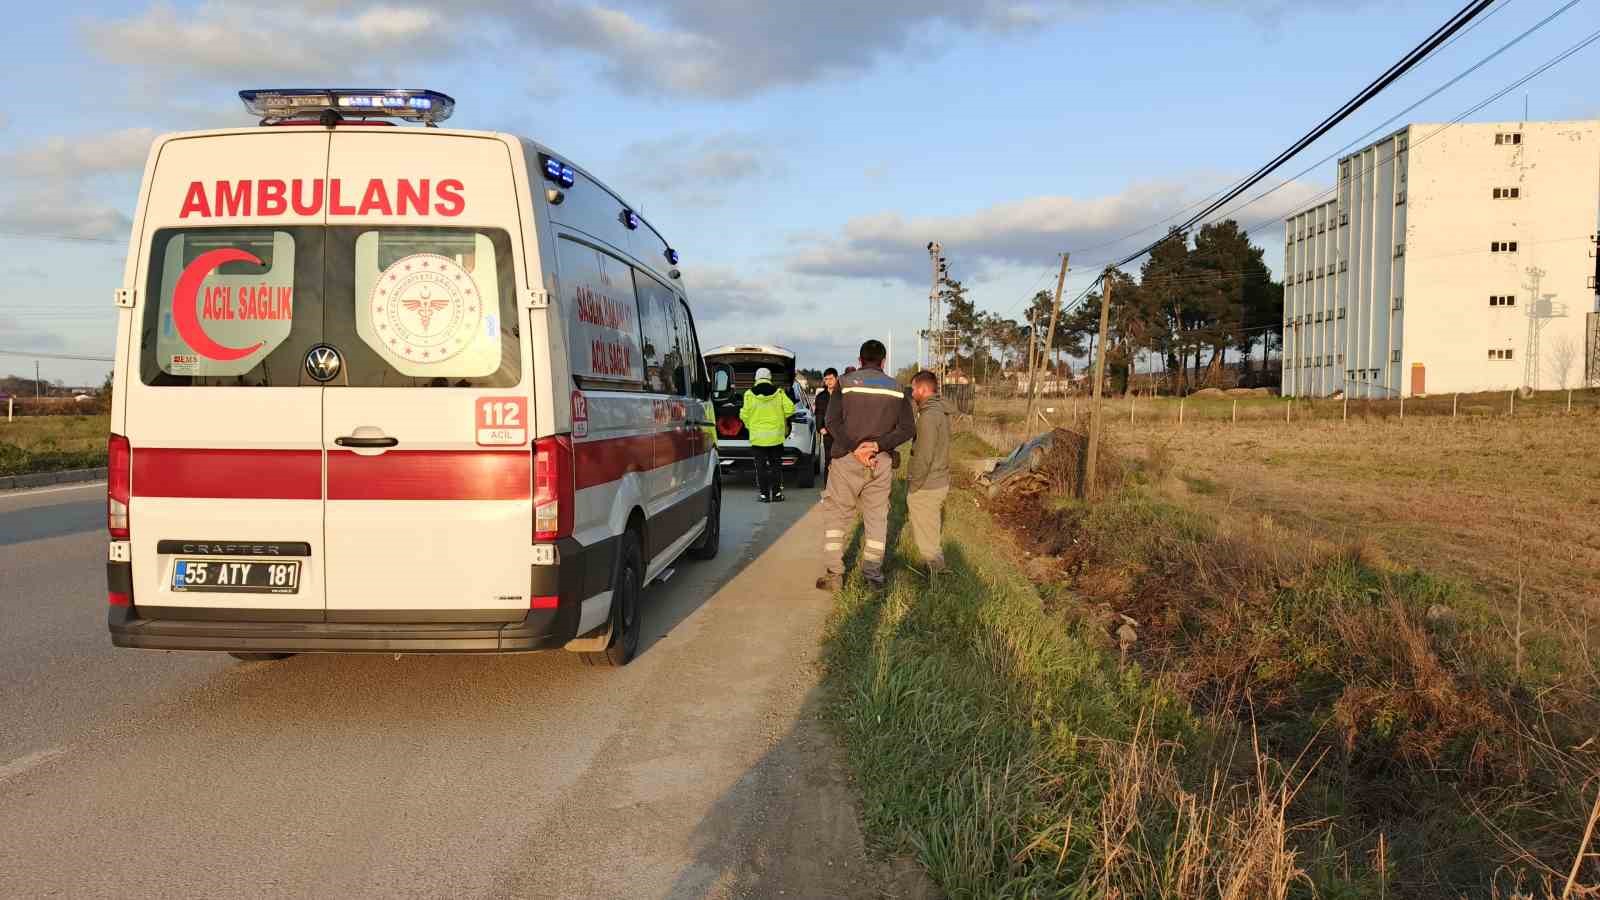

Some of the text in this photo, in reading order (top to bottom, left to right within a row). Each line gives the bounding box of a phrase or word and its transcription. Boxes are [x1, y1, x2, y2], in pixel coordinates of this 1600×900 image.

[179, 178, 466, 218] AMBULANS
[238, 283, 293, 320] SAĞLIK
[482, 402, 520, 426] 112
[183, 543, 280, 555] CRAFTER
[185, 563, 208, 584] 55
[217, 563, 251, 585] ATY
[268, 565, 295, 586] 181
